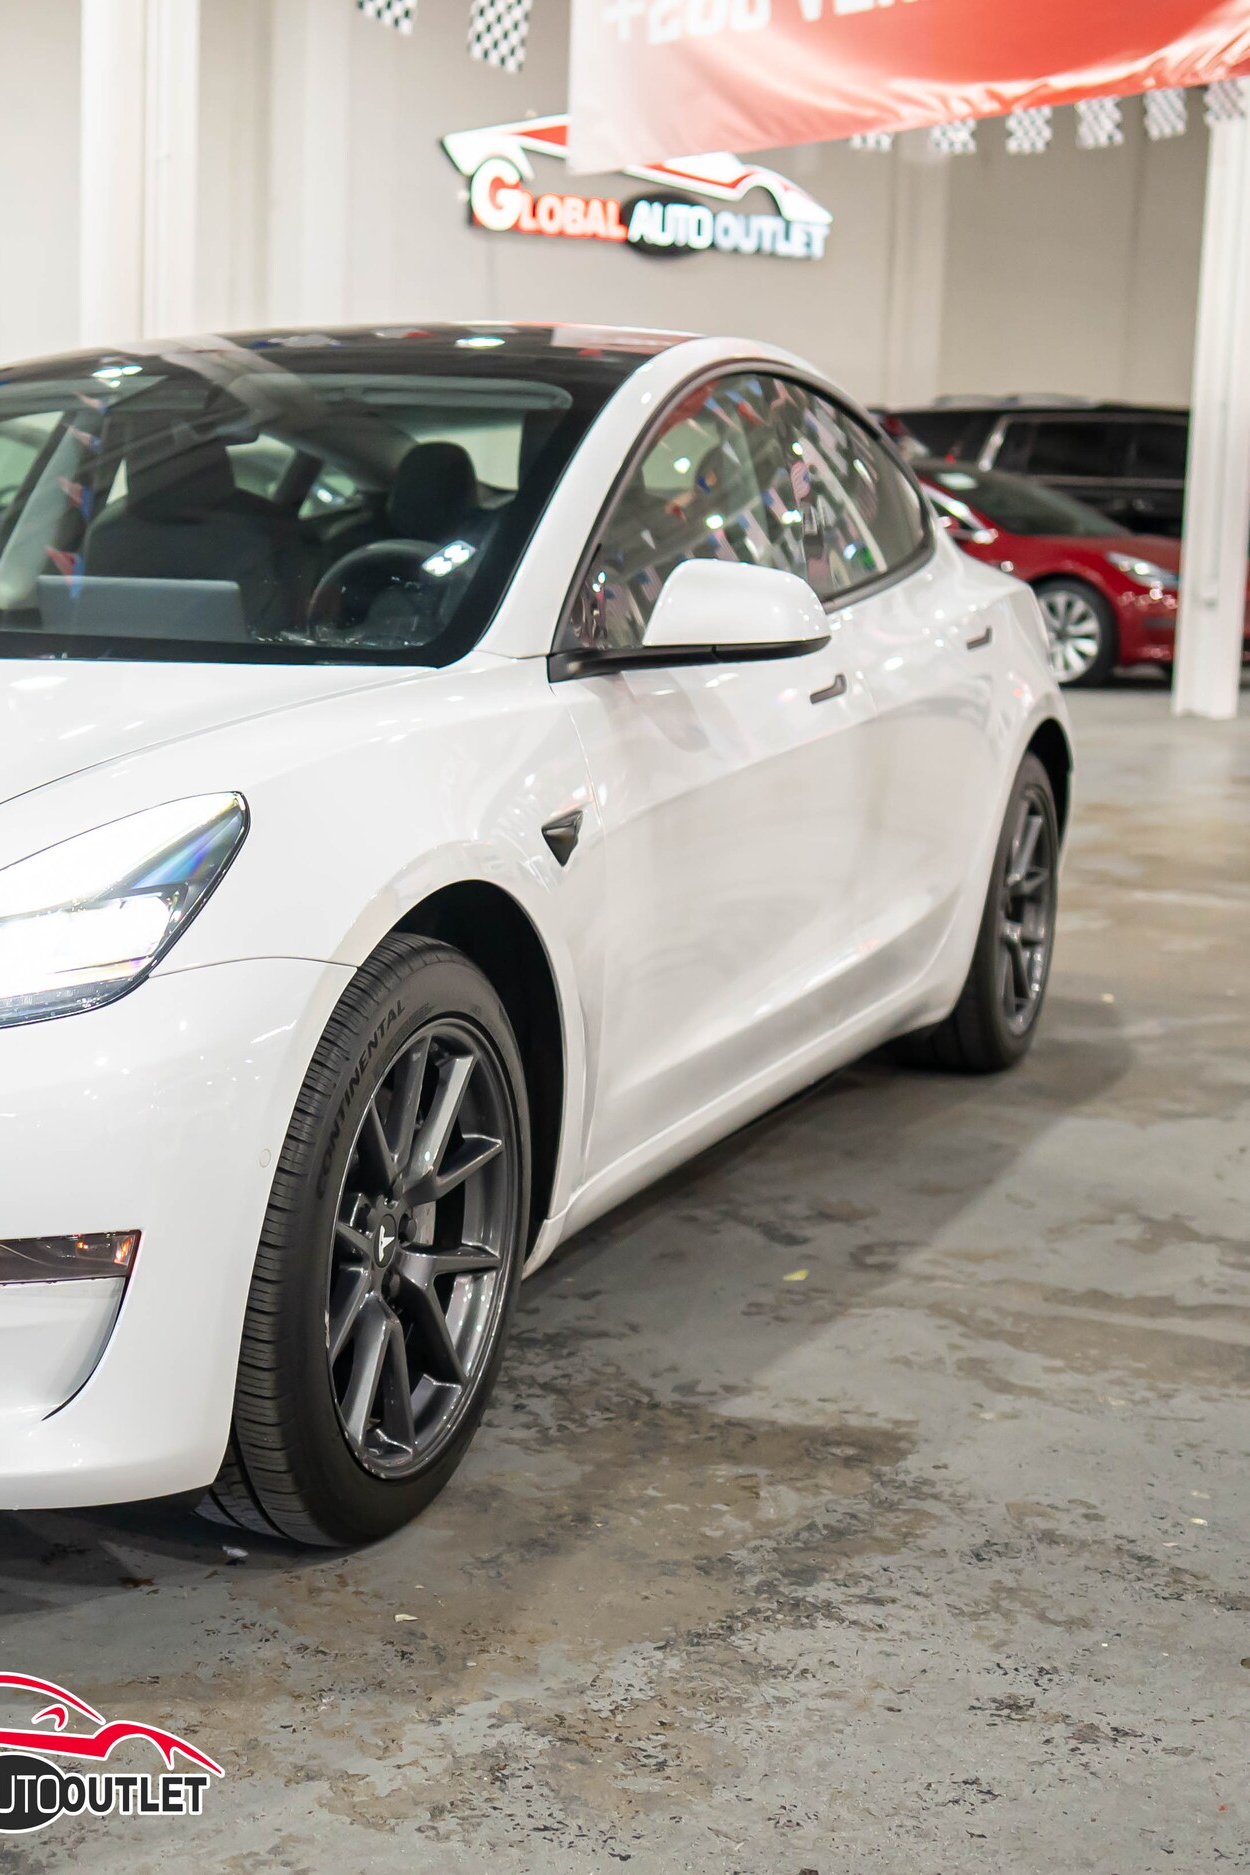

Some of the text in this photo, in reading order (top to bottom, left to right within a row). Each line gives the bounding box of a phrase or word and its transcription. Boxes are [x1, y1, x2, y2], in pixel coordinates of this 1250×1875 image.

[471, 156, 830, 259] GLOBAL AUTO OUTLET
[316, 1000, 405, 1199] CONTINENTAL
